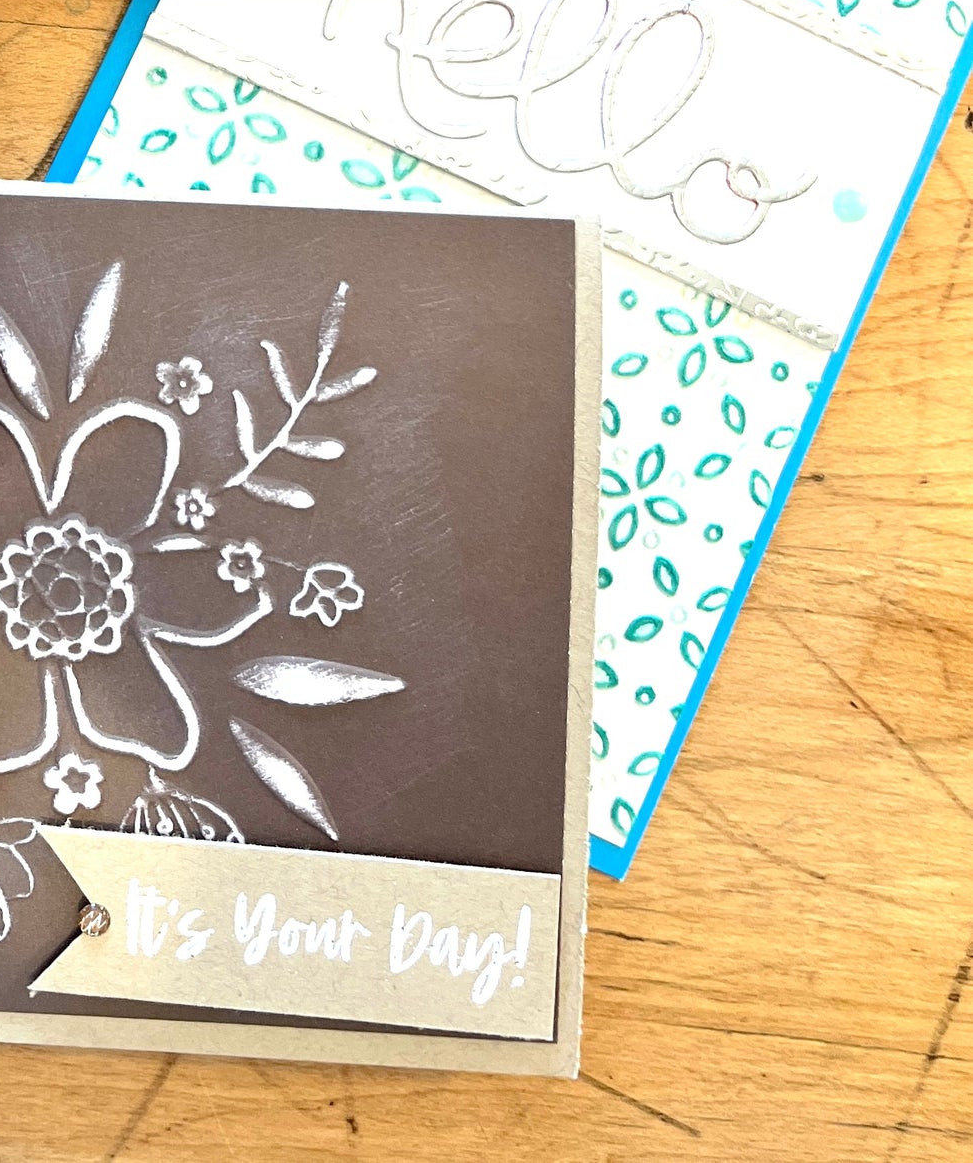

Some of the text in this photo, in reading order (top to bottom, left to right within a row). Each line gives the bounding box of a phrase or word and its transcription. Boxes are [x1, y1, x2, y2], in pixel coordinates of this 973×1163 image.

[126, 877, 533, 1006] It's Your Day!
